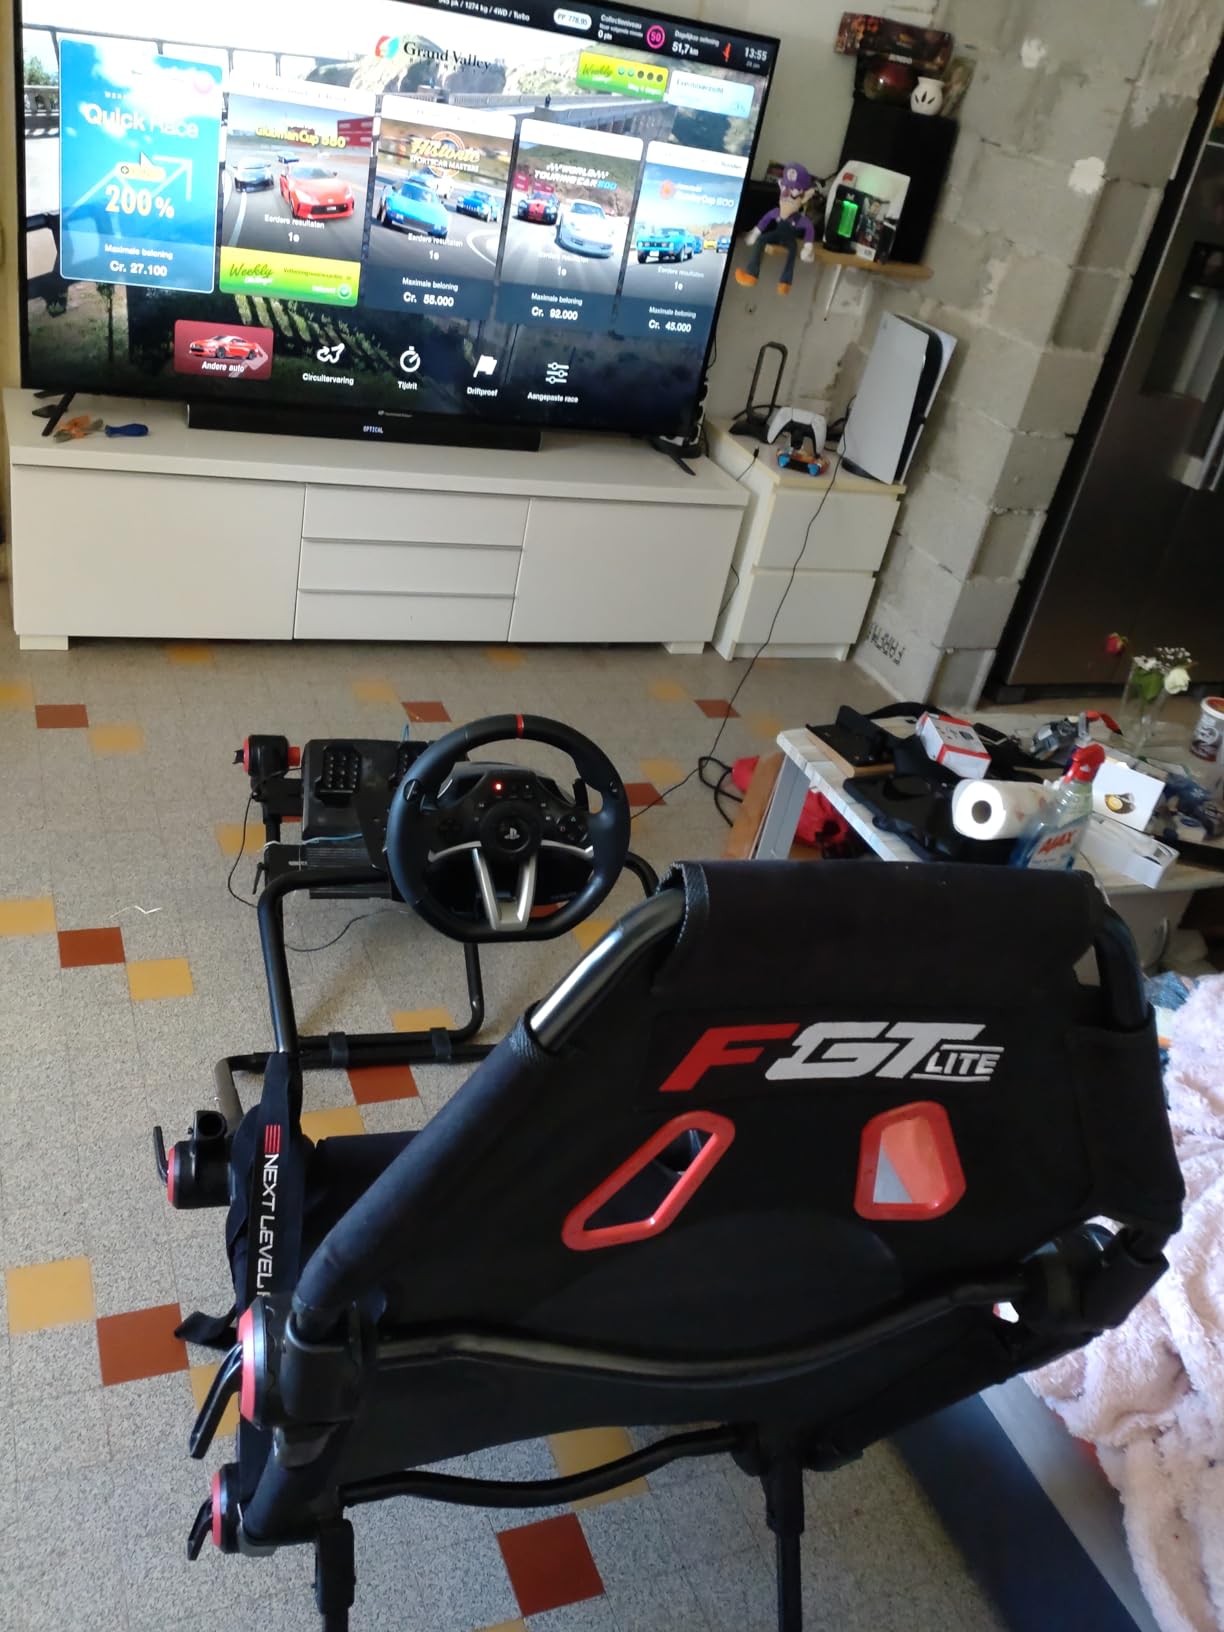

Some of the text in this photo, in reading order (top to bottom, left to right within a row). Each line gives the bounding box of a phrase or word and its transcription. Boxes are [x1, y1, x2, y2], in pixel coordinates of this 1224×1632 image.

[465, 2, 479, 11] 1274
[480, 5, 488, 14] kg
[493, 7, 508, 16] 4WD
[513, 11, 530, 22] Turbo
[597, 29, 603, 39] 0
[650, 31, 661, 42] 50
[403, 41, 492, 70] Grand Valley
[671, 41, 699, 57] 51,7 km
[744, 46, 768, 62] 13:55
[84, 102, 146, 132] Quick
[287, 231, 300, 243] 1e
[104, 243, 174, 261] Maximale beloning
[428, 249, 440, 261] 1e
[109, 260, 168, 277] Cr. 27.100
[229, 263, 274, 278] Weekly
[402, 276, 459, 293] Maximale beloning
[403, 291, 417, 304] Cr.
[531, 292, 583, 307] Maximale beloning
[531, 306, 579, 321] Cr. 92.000
[648, 305, 697, 320] Maximale beloning
[648, 319, 692, 333] Cr. 45.000
[201, 360, 245, 373] Andere auto
[302, 372, 355, 386] Circuitervaring
[397, 380, 418, 391] Tijdrit
[466, 386, 499, 397] Driftproef
[527, 391, 579, 403] Aangepaste race
[362, 425, 384, 435] OPTICAL
[925, 1051, 1001, 1075] LITE
[261, 1153, 280, 1212] NEXT
[256, 1215, 276, 1289] LEVEL
